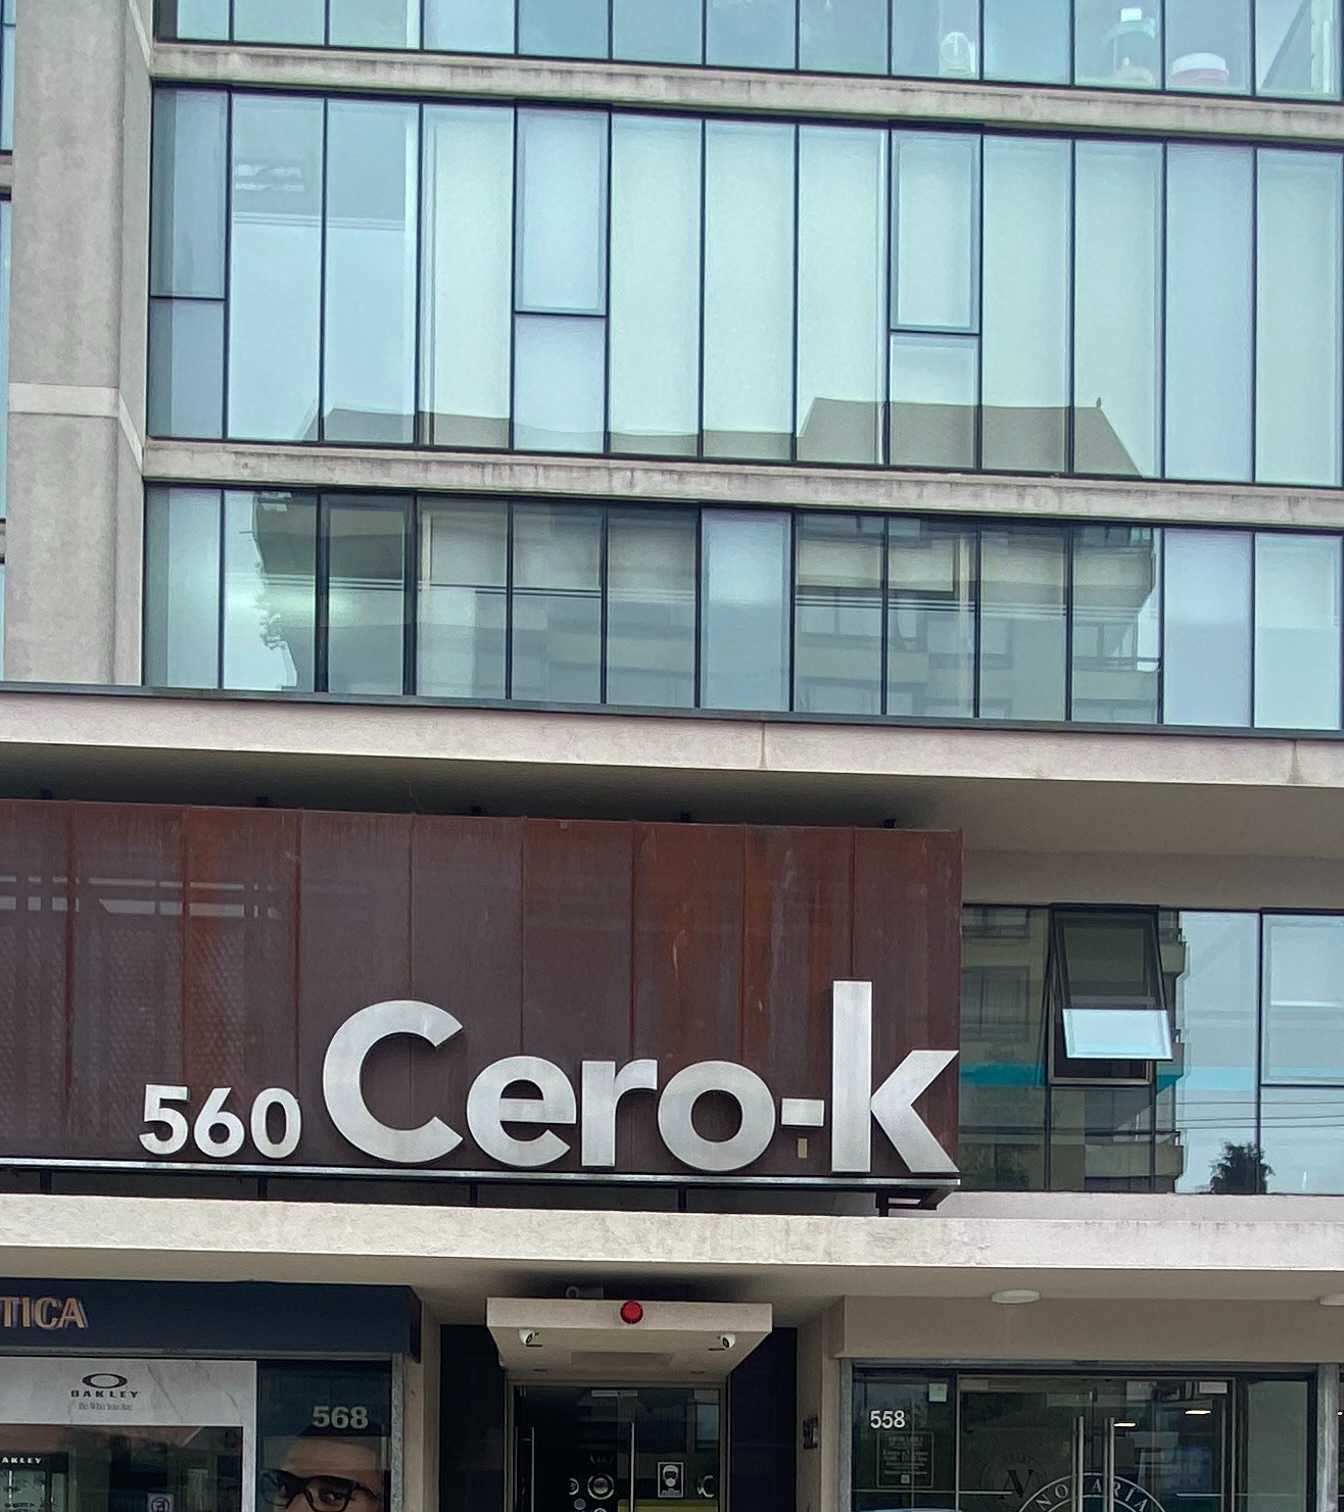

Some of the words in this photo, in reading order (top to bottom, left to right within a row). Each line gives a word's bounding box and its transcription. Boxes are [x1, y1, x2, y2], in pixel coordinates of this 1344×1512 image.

[138, 1083, 302, 1159] 560
[322, 980, 960, 1174] Cero-k
[70, 1390, 139, 1399] OAKLEY
[311, 1406, 370, 1430] 568
[869, 1410, 906, 1429] 558
